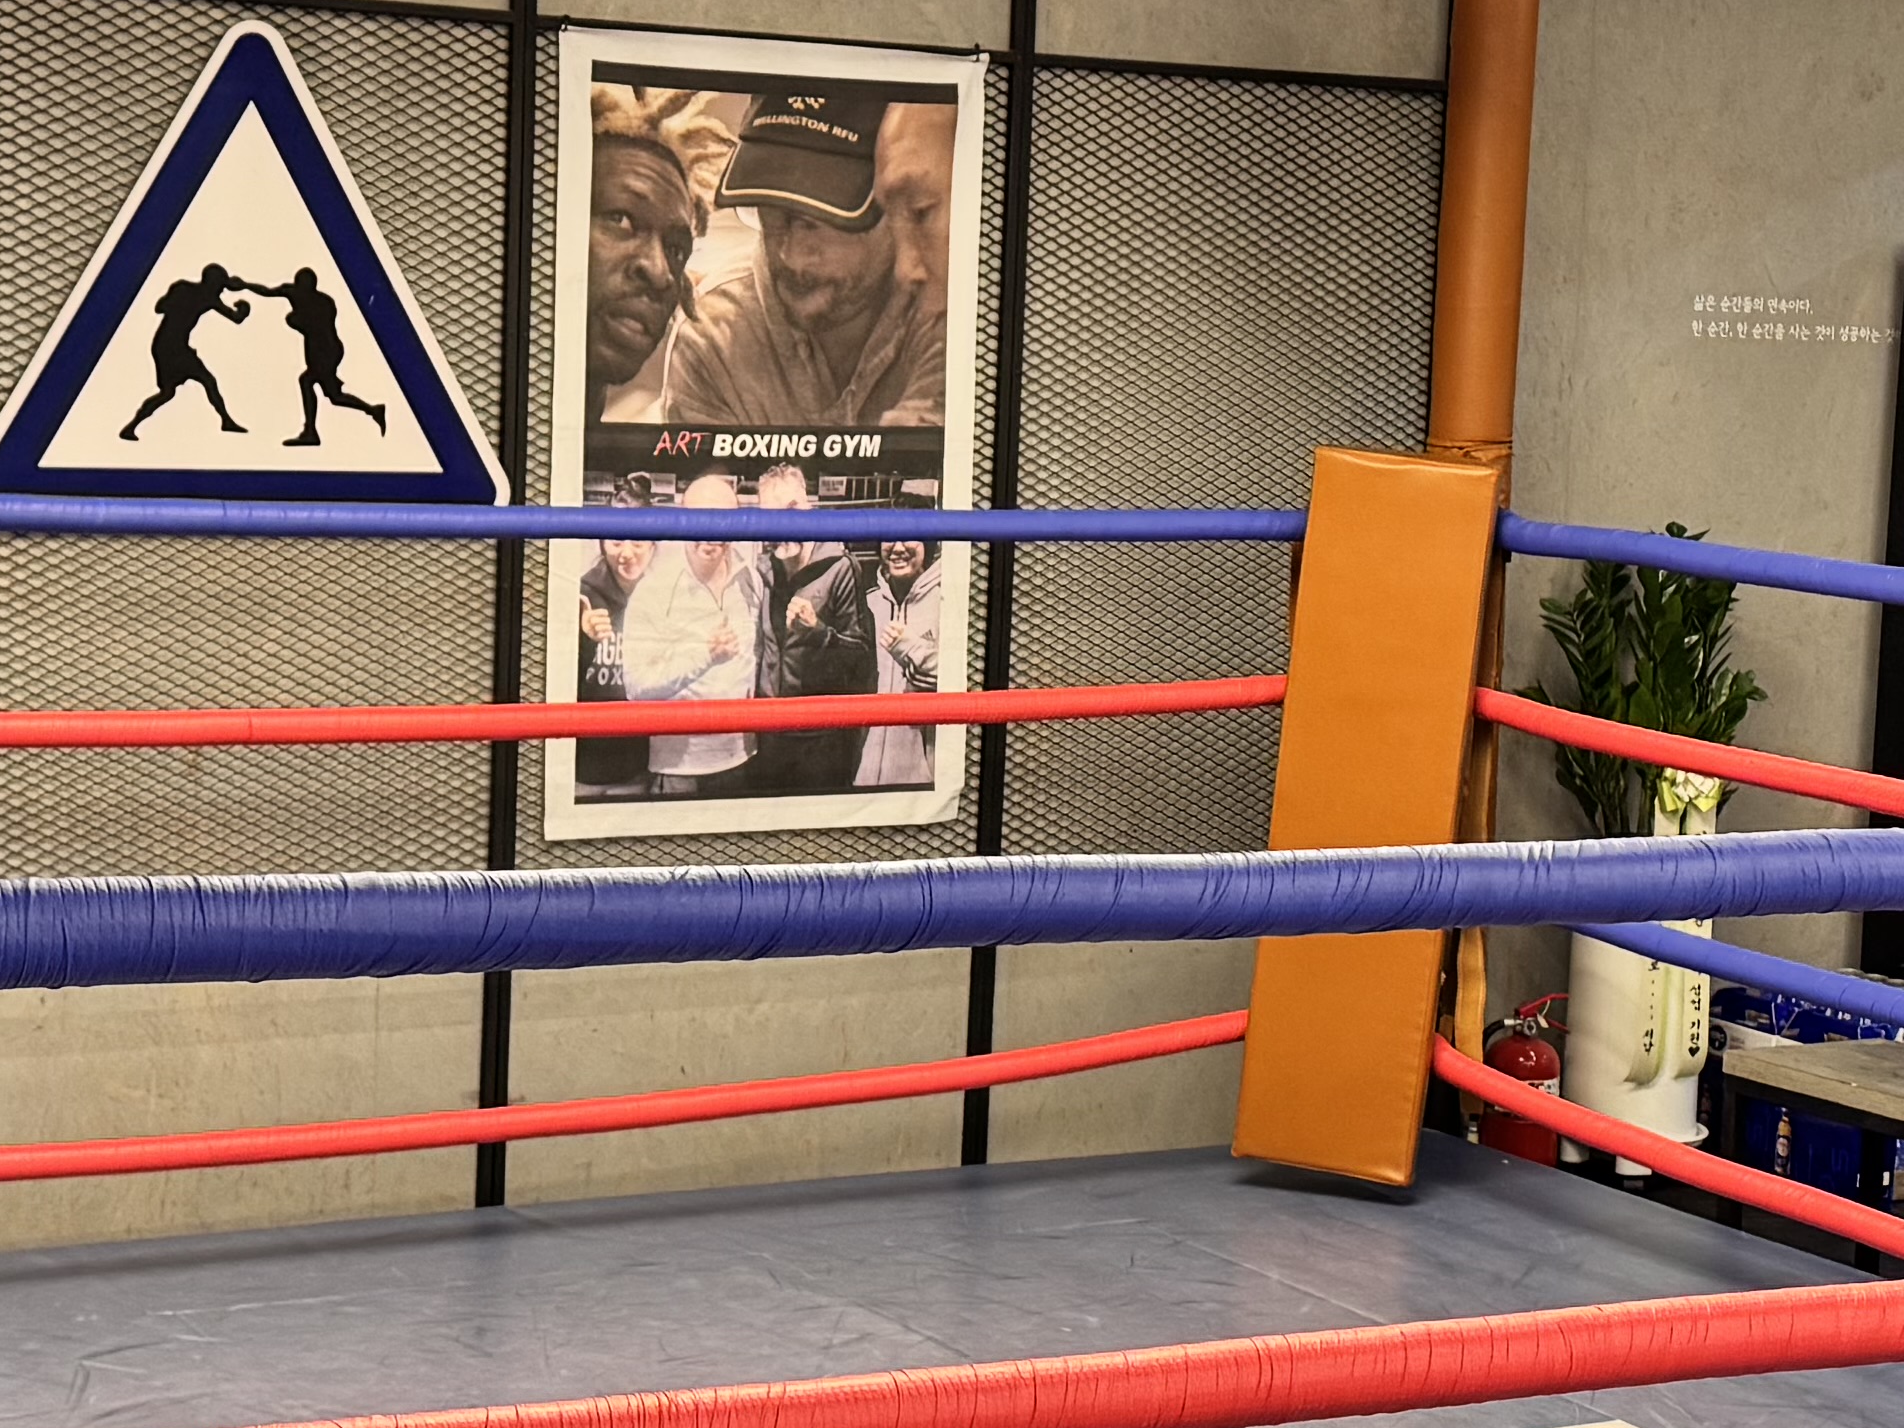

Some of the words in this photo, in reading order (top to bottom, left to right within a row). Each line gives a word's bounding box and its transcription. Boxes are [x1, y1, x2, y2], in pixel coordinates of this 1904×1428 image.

[652, 430, 713, 458] ART
[711, 432, 818, 458] BOXING
[822, 433, 883, 458] GYM
